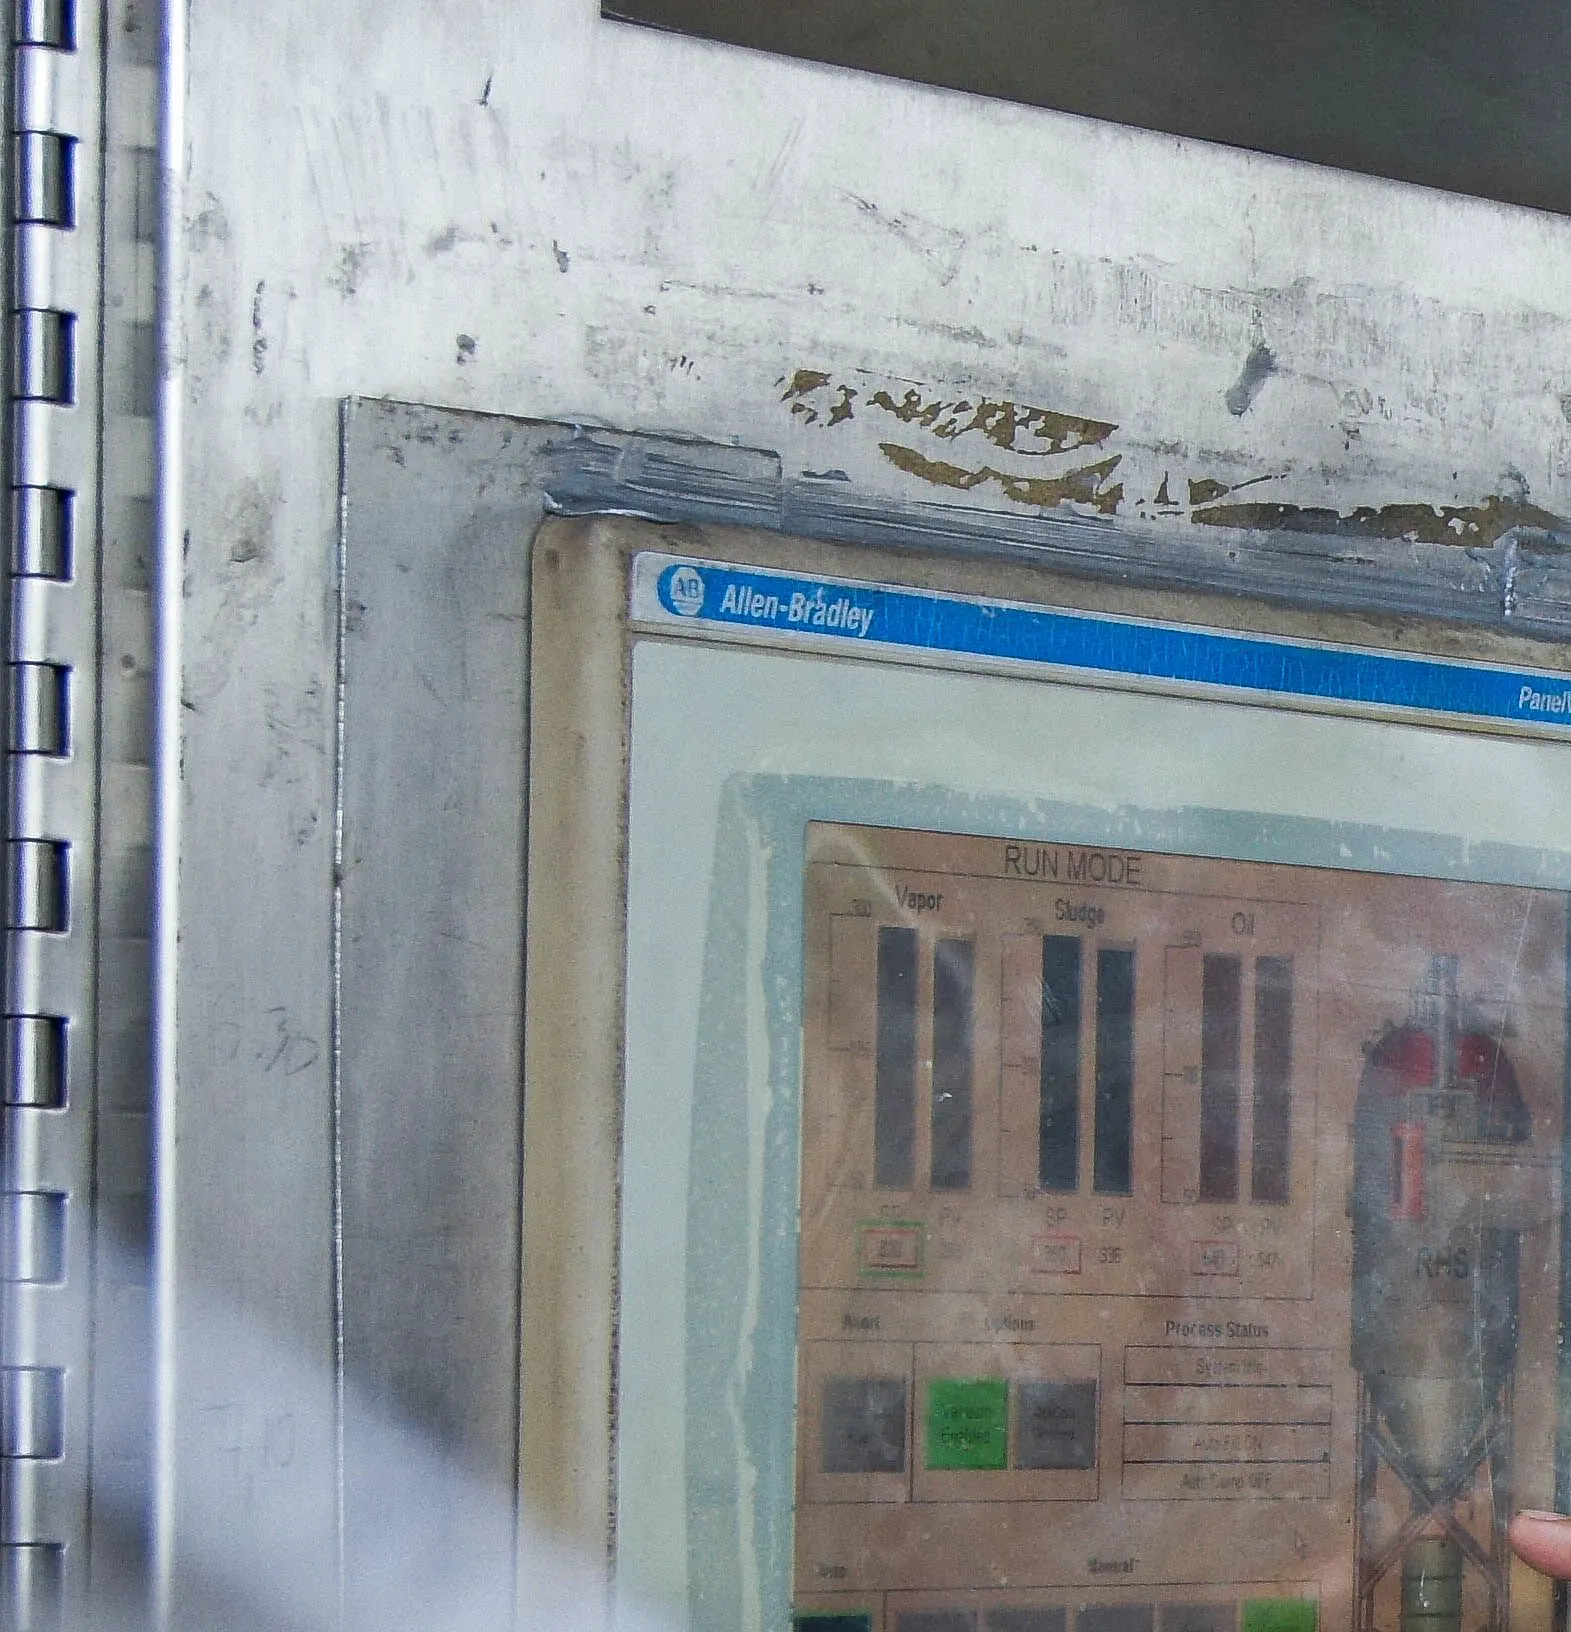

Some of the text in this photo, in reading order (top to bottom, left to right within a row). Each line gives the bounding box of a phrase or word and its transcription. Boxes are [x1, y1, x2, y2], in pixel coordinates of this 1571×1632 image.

[719, 583, 873, 637] Allen-Bradley
[1004, 845, 1143, 886] RUN MODE
[895, 884, 944, 913] Vapor
[1054, 898, 1105, 929] Sludge
[1230, 911, 1255, 936] Oil
[1165, 1318, 1270, 1339] Process Status
